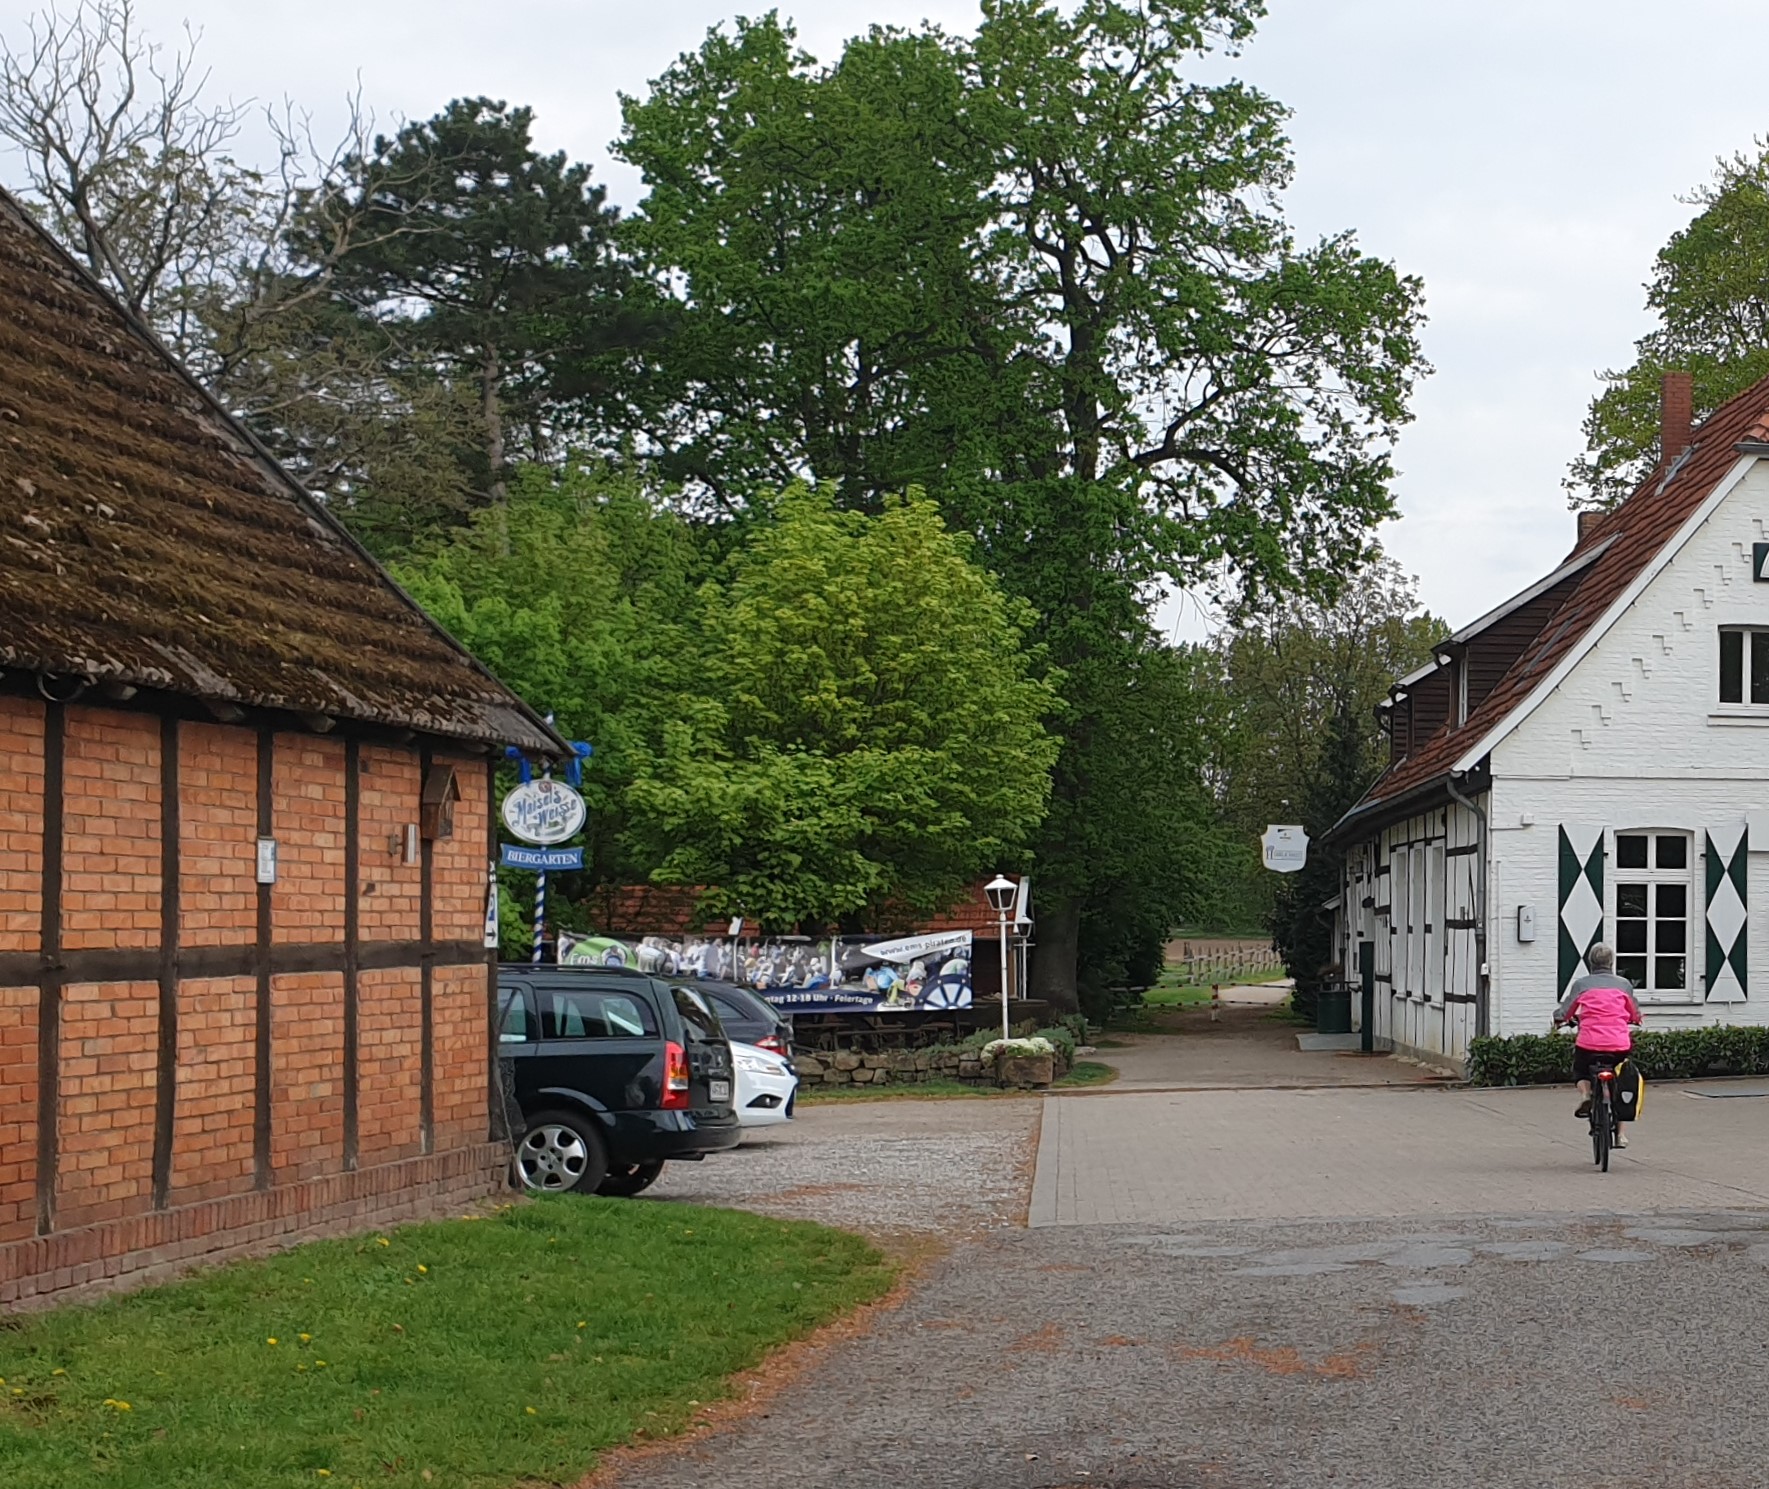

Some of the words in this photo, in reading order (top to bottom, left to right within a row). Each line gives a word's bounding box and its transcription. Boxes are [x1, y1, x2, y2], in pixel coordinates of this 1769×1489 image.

[512, 786, 562, 827] Maisel's
[507, 850, 578, 865] BIERGARTEN
[764, 995, 785, 1004] ntag
[813, 993, 829, 1002] Uhr
[834, 994, 874, 1005] Feiertage
